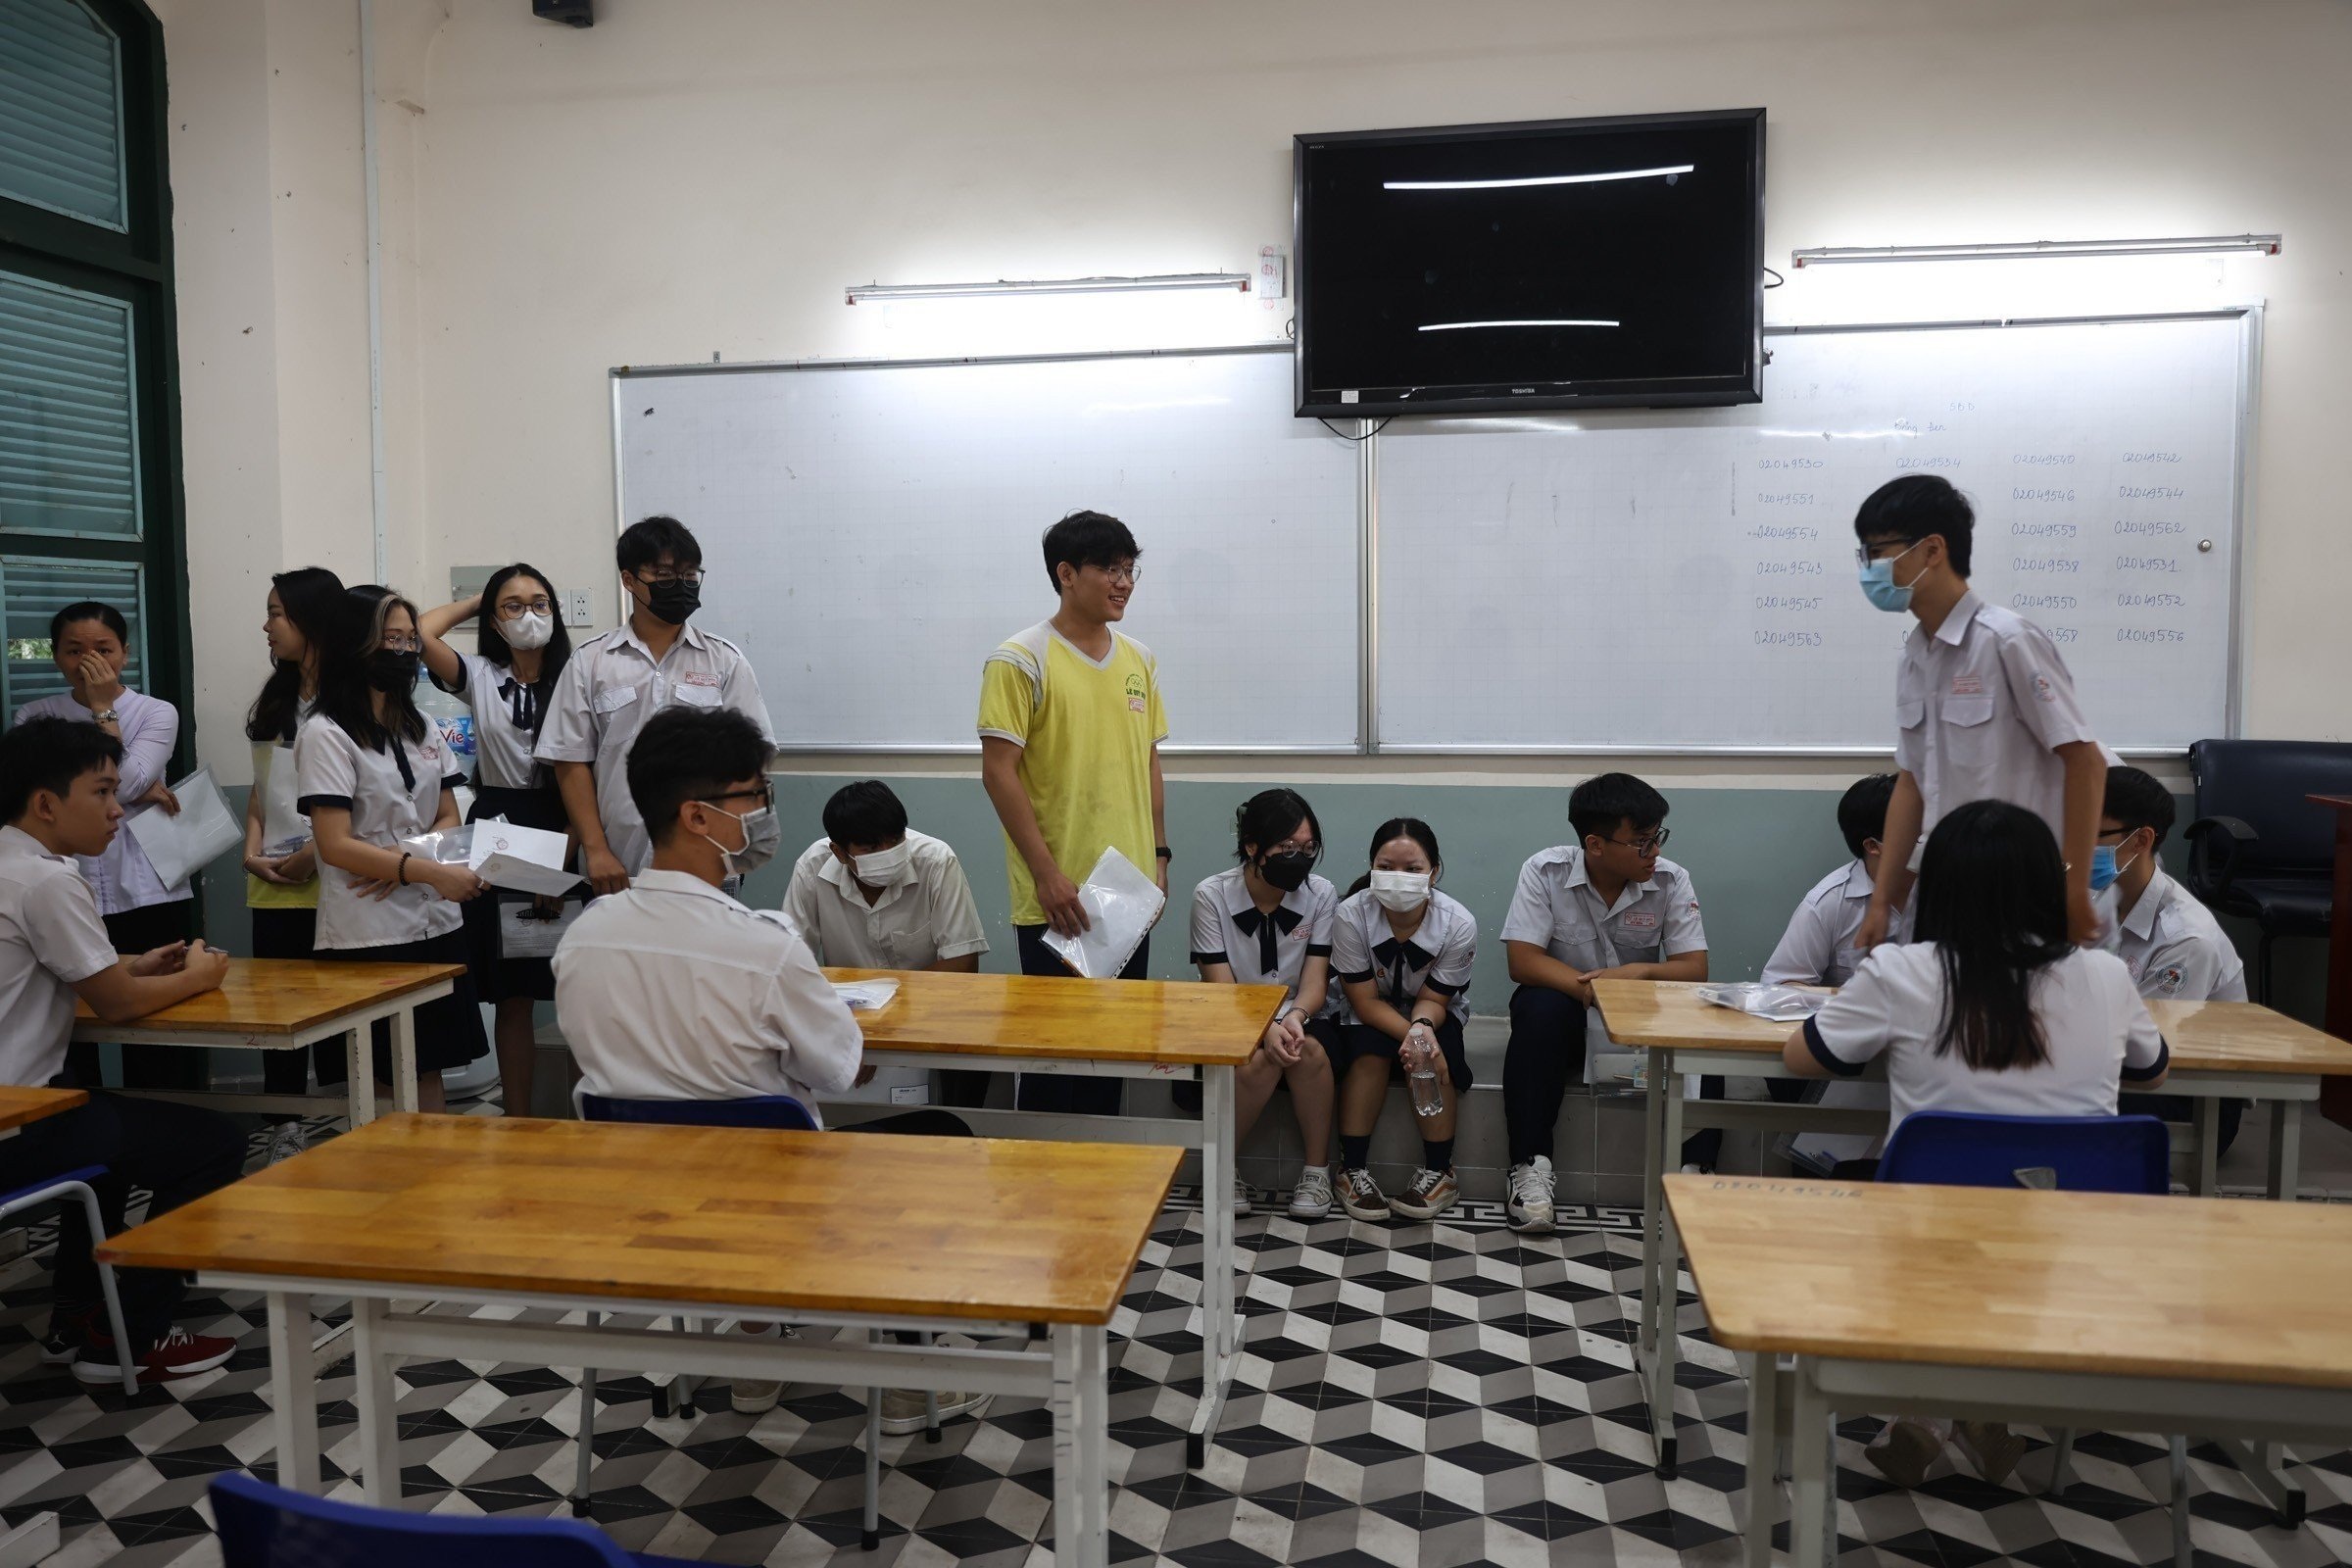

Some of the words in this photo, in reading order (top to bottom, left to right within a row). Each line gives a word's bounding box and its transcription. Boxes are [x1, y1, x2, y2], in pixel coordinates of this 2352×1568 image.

[1758, 458, 1824, 469] 02049530
[2012, 454, 2076, 466] 02049540
[2122, 452, 2182, 464] 02049542
[2012, 487, 2076, 503] 02049546
[2119, 486, 2184, 500] 02049544
[2011, 522, 2077, 538] 02049559
[2114, 520, 2187, 537] 02049562
[2012, 557, 2080, 572] 02049538
[1755, 596, 1824, 611] 02049545
[2012, 593, 2078, 609] 02049550
[2117, 593, 2186, 607] 02049552
[1754, 630, 1822, 647] 02049563
[2117, 628, 2184, 643] 02049556
